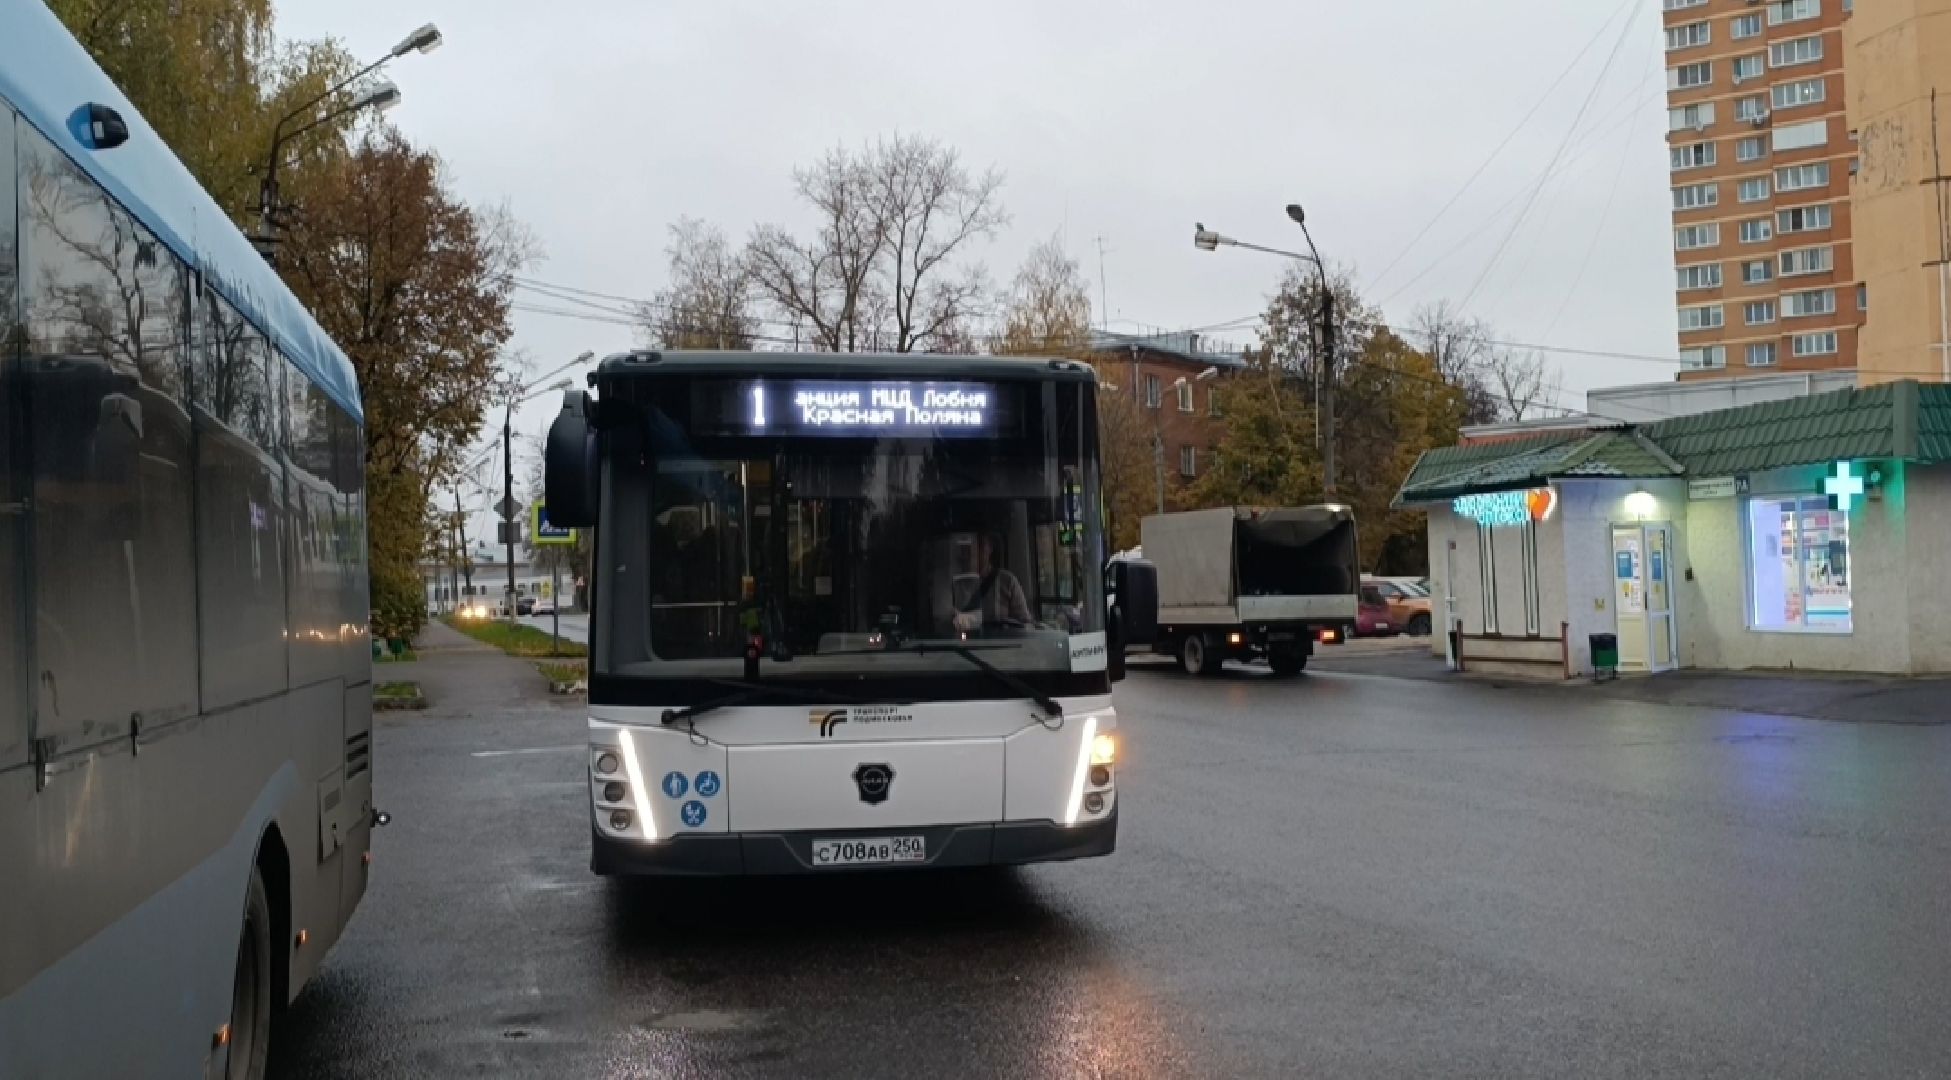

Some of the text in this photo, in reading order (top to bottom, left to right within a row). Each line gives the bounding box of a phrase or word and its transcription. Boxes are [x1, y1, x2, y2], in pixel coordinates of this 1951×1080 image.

[754, 387, 765, 424] 1
[924, 390, 987, 407] Лобня
[803, 405, 982, 425] Красная Поляна
